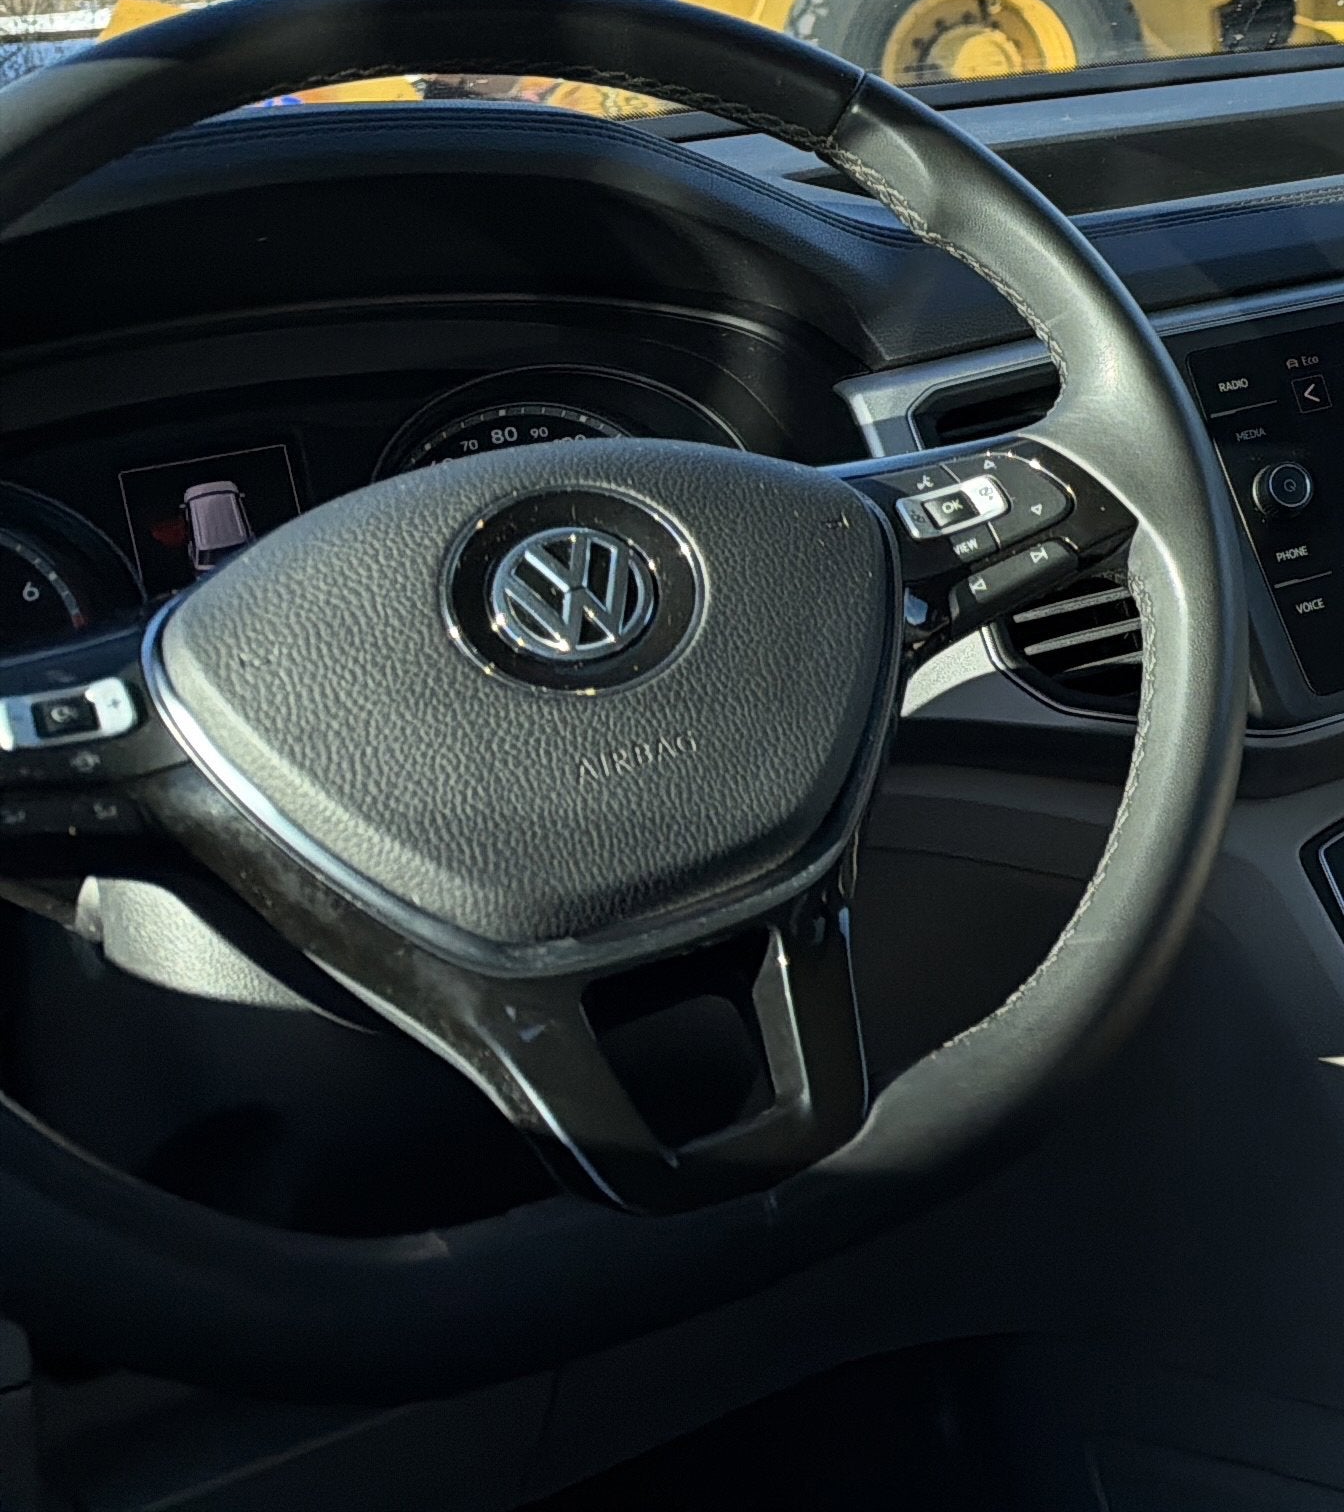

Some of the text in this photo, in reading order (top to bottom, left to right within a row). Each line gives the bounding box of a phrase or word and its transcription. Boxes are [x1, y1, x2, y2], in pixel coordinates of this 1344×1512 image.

[1301, 355, 1320, 367] Eco
[1218, 378, 1249, 393] RADIO
[490, 426, 518, 445] 80
[529, 426, 549, 439] 90
[1235, 427, 1267, 442] MEDIA
[460, 439, 479, 452] 70
[942, 498, 963, 514] OK
[953, 538, 979, 556] VIEW
[1276, 545, 1308, 563] PHONE
[22, 581, 40, 602] 6
[1296, 597, 1325, 615] VOICE
[578, 730, 697, 789] AIRBAG
